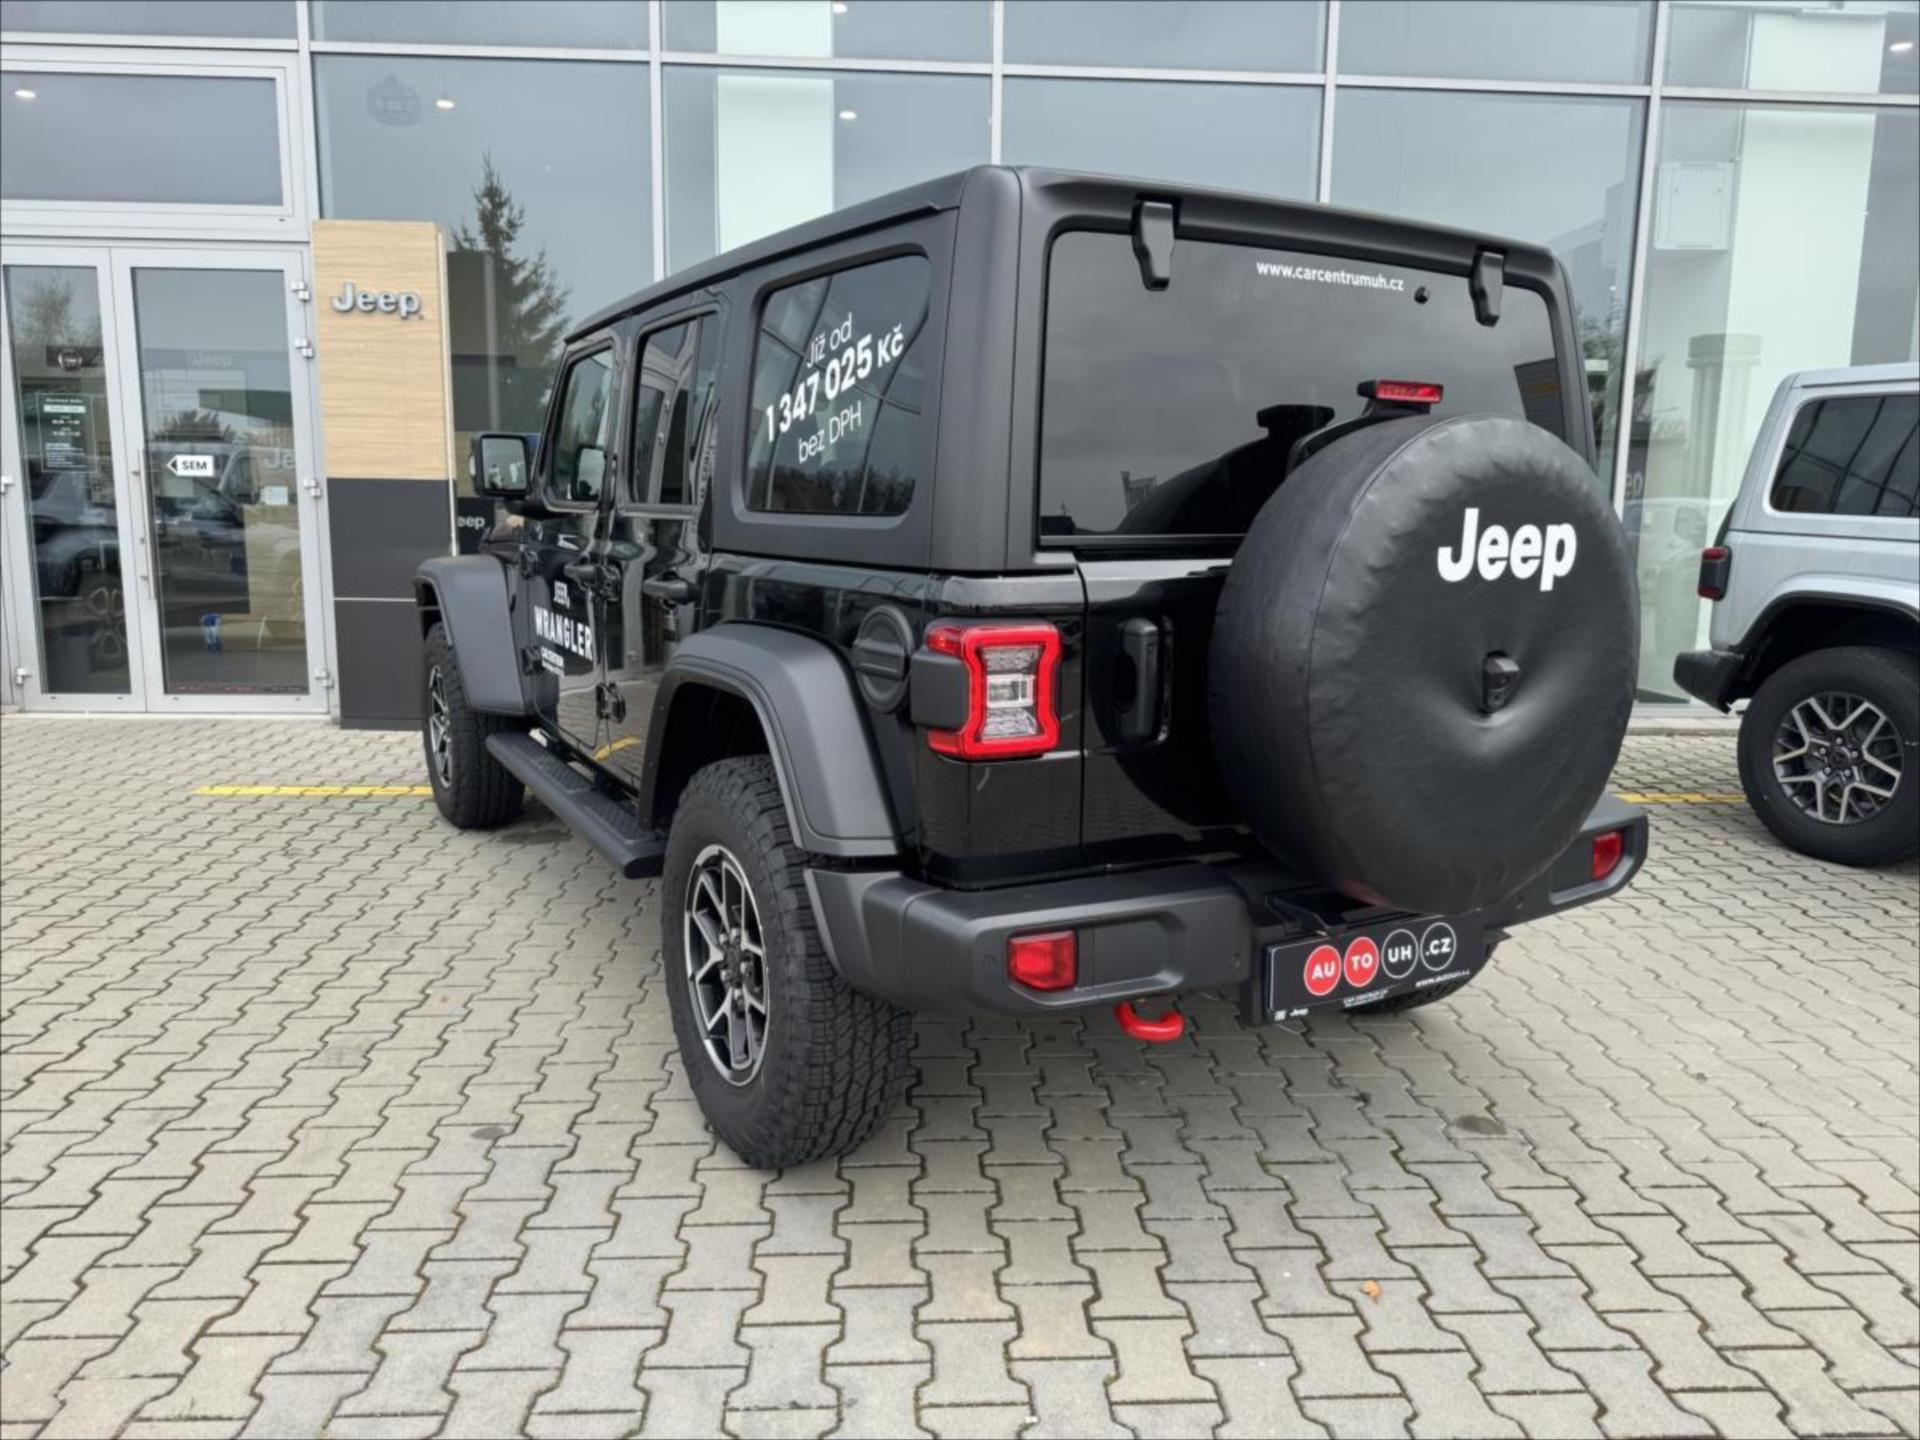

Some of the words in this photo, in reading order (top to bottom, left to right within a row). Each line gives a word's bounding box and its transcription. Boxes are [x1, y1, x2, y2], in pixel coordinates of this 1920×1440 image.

[1256, 262, 1404, 291] www.carcentrumuh.cz
[331, 281, 421, 319] Jeep
[806, 332, 826, 368] Již
[829, 312, 852, 350] od
[766, 405, 774, 442] 1
[779, 371, 820, 433] 347
[824, 333, 872, 400] 025
[877, 323, 904, 368] Kč
[798, 429, 825, 465] bez
[829, 400, 862, 444] DPH
[181, 460, 207, 471] SEM
[265, 447, 296, 470] Je
[457, 516, 486, 530] eep
[1437, 507, 1577, 591] Jeep
[534, 605, 593, 661] WRANGLER
[1311, 963, 1336, 980] AU
[1351, 953, 1373, 972] TO
[1388, 943, 1413, 963] UH
[1424, 937, 1452, 956] .CZ
